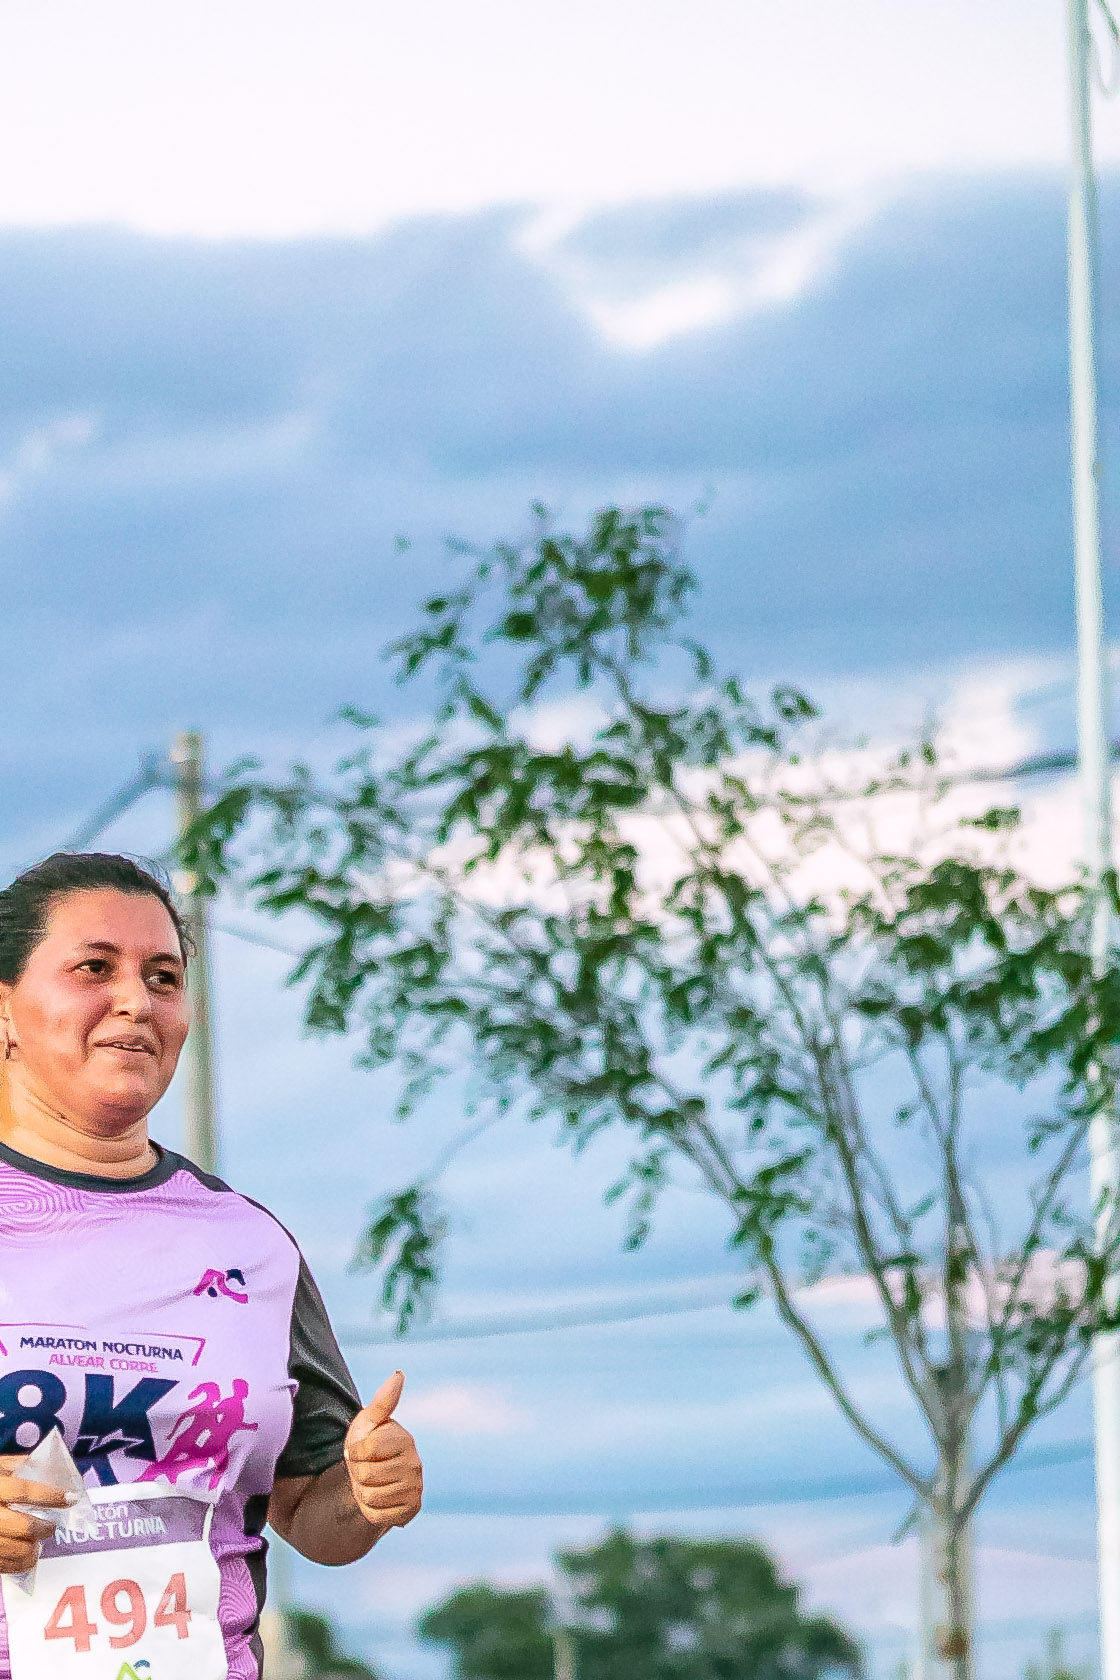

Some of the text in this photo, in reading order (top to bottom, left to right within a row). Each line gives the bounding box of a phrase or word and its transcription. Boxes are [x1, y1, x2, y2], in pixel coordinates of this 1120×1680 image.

[19, 1336, 184, 1361] MARATON NOCTURNA
[48, 1353, 159, 1373] ALVEAR CORRE
[43, 1572, 192, 1653] 494
